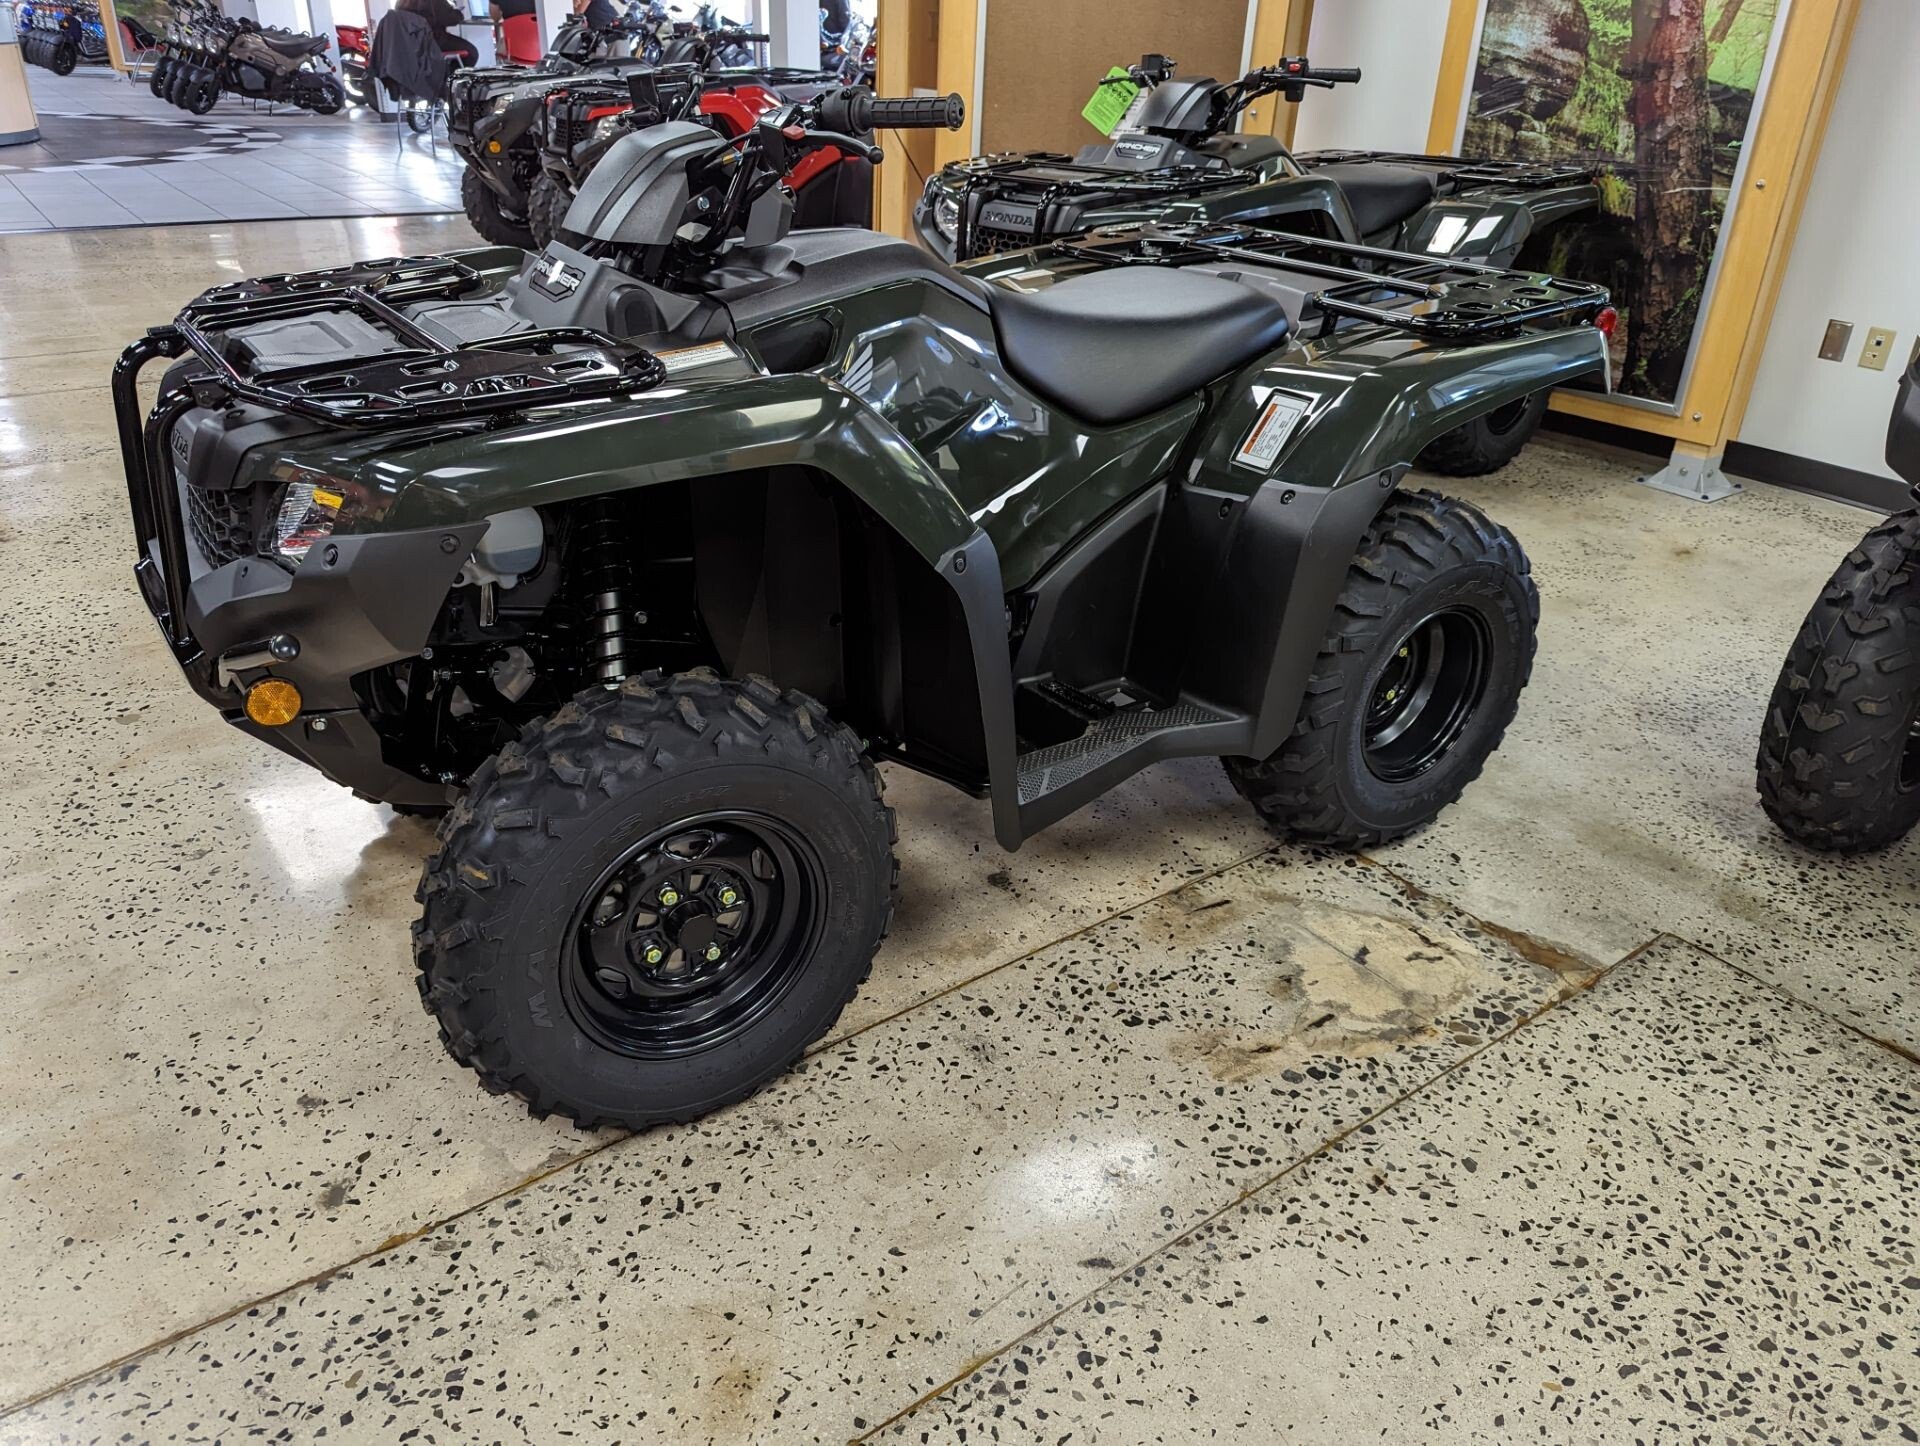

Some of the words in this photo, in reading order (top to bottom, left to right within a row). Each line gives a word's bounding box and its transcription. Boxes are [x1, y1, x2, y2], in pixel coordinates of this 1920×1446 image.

[1116, 142, 1161, 154] RANCHER
[984, 210, 1034, 226] HONDA
[537, 259, 580, 291] RANER
